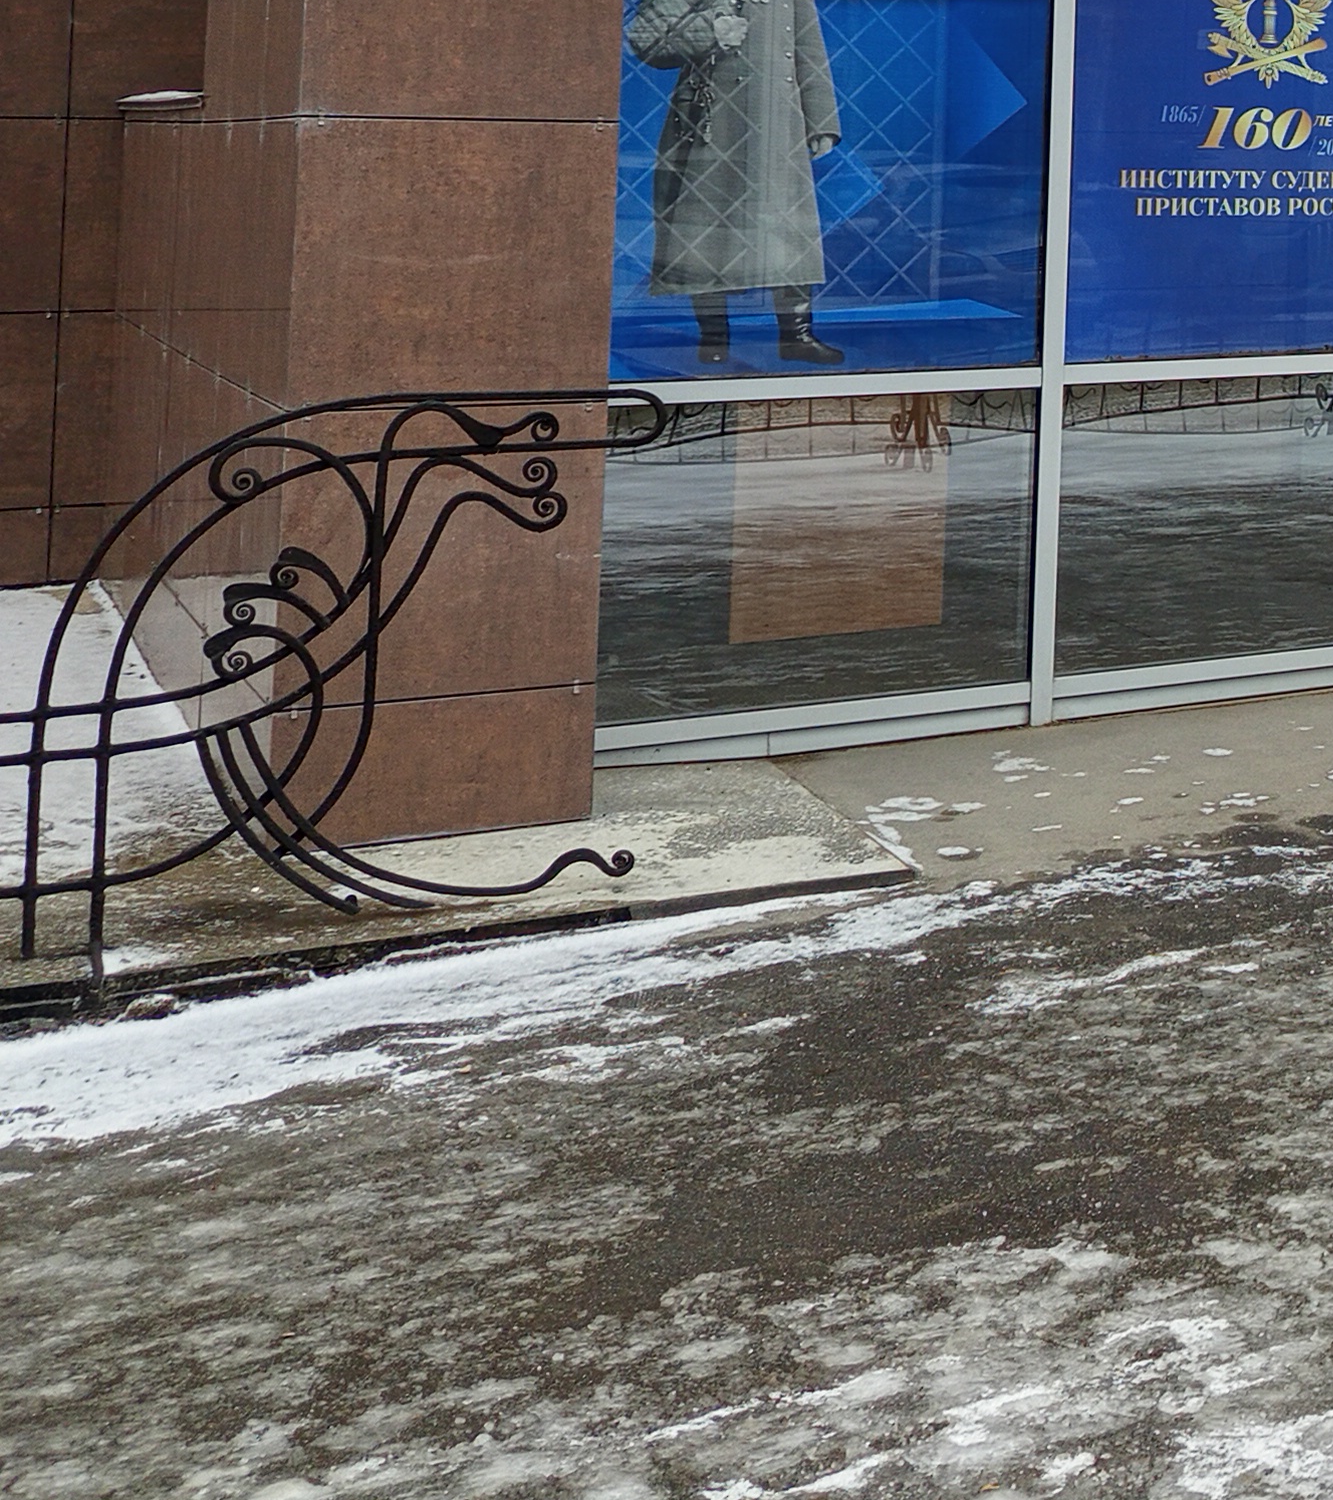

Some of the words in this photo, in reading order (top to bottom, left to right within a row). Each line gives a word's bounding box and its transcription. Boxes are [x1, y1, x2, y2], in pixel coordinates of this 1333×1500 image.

[1197, 106, 1313, 151] 160
[1119, 168, 1266, 190] ИНСТИТУТУ
[1135, 197, 1282, 217] ПРИСТАВОВ
